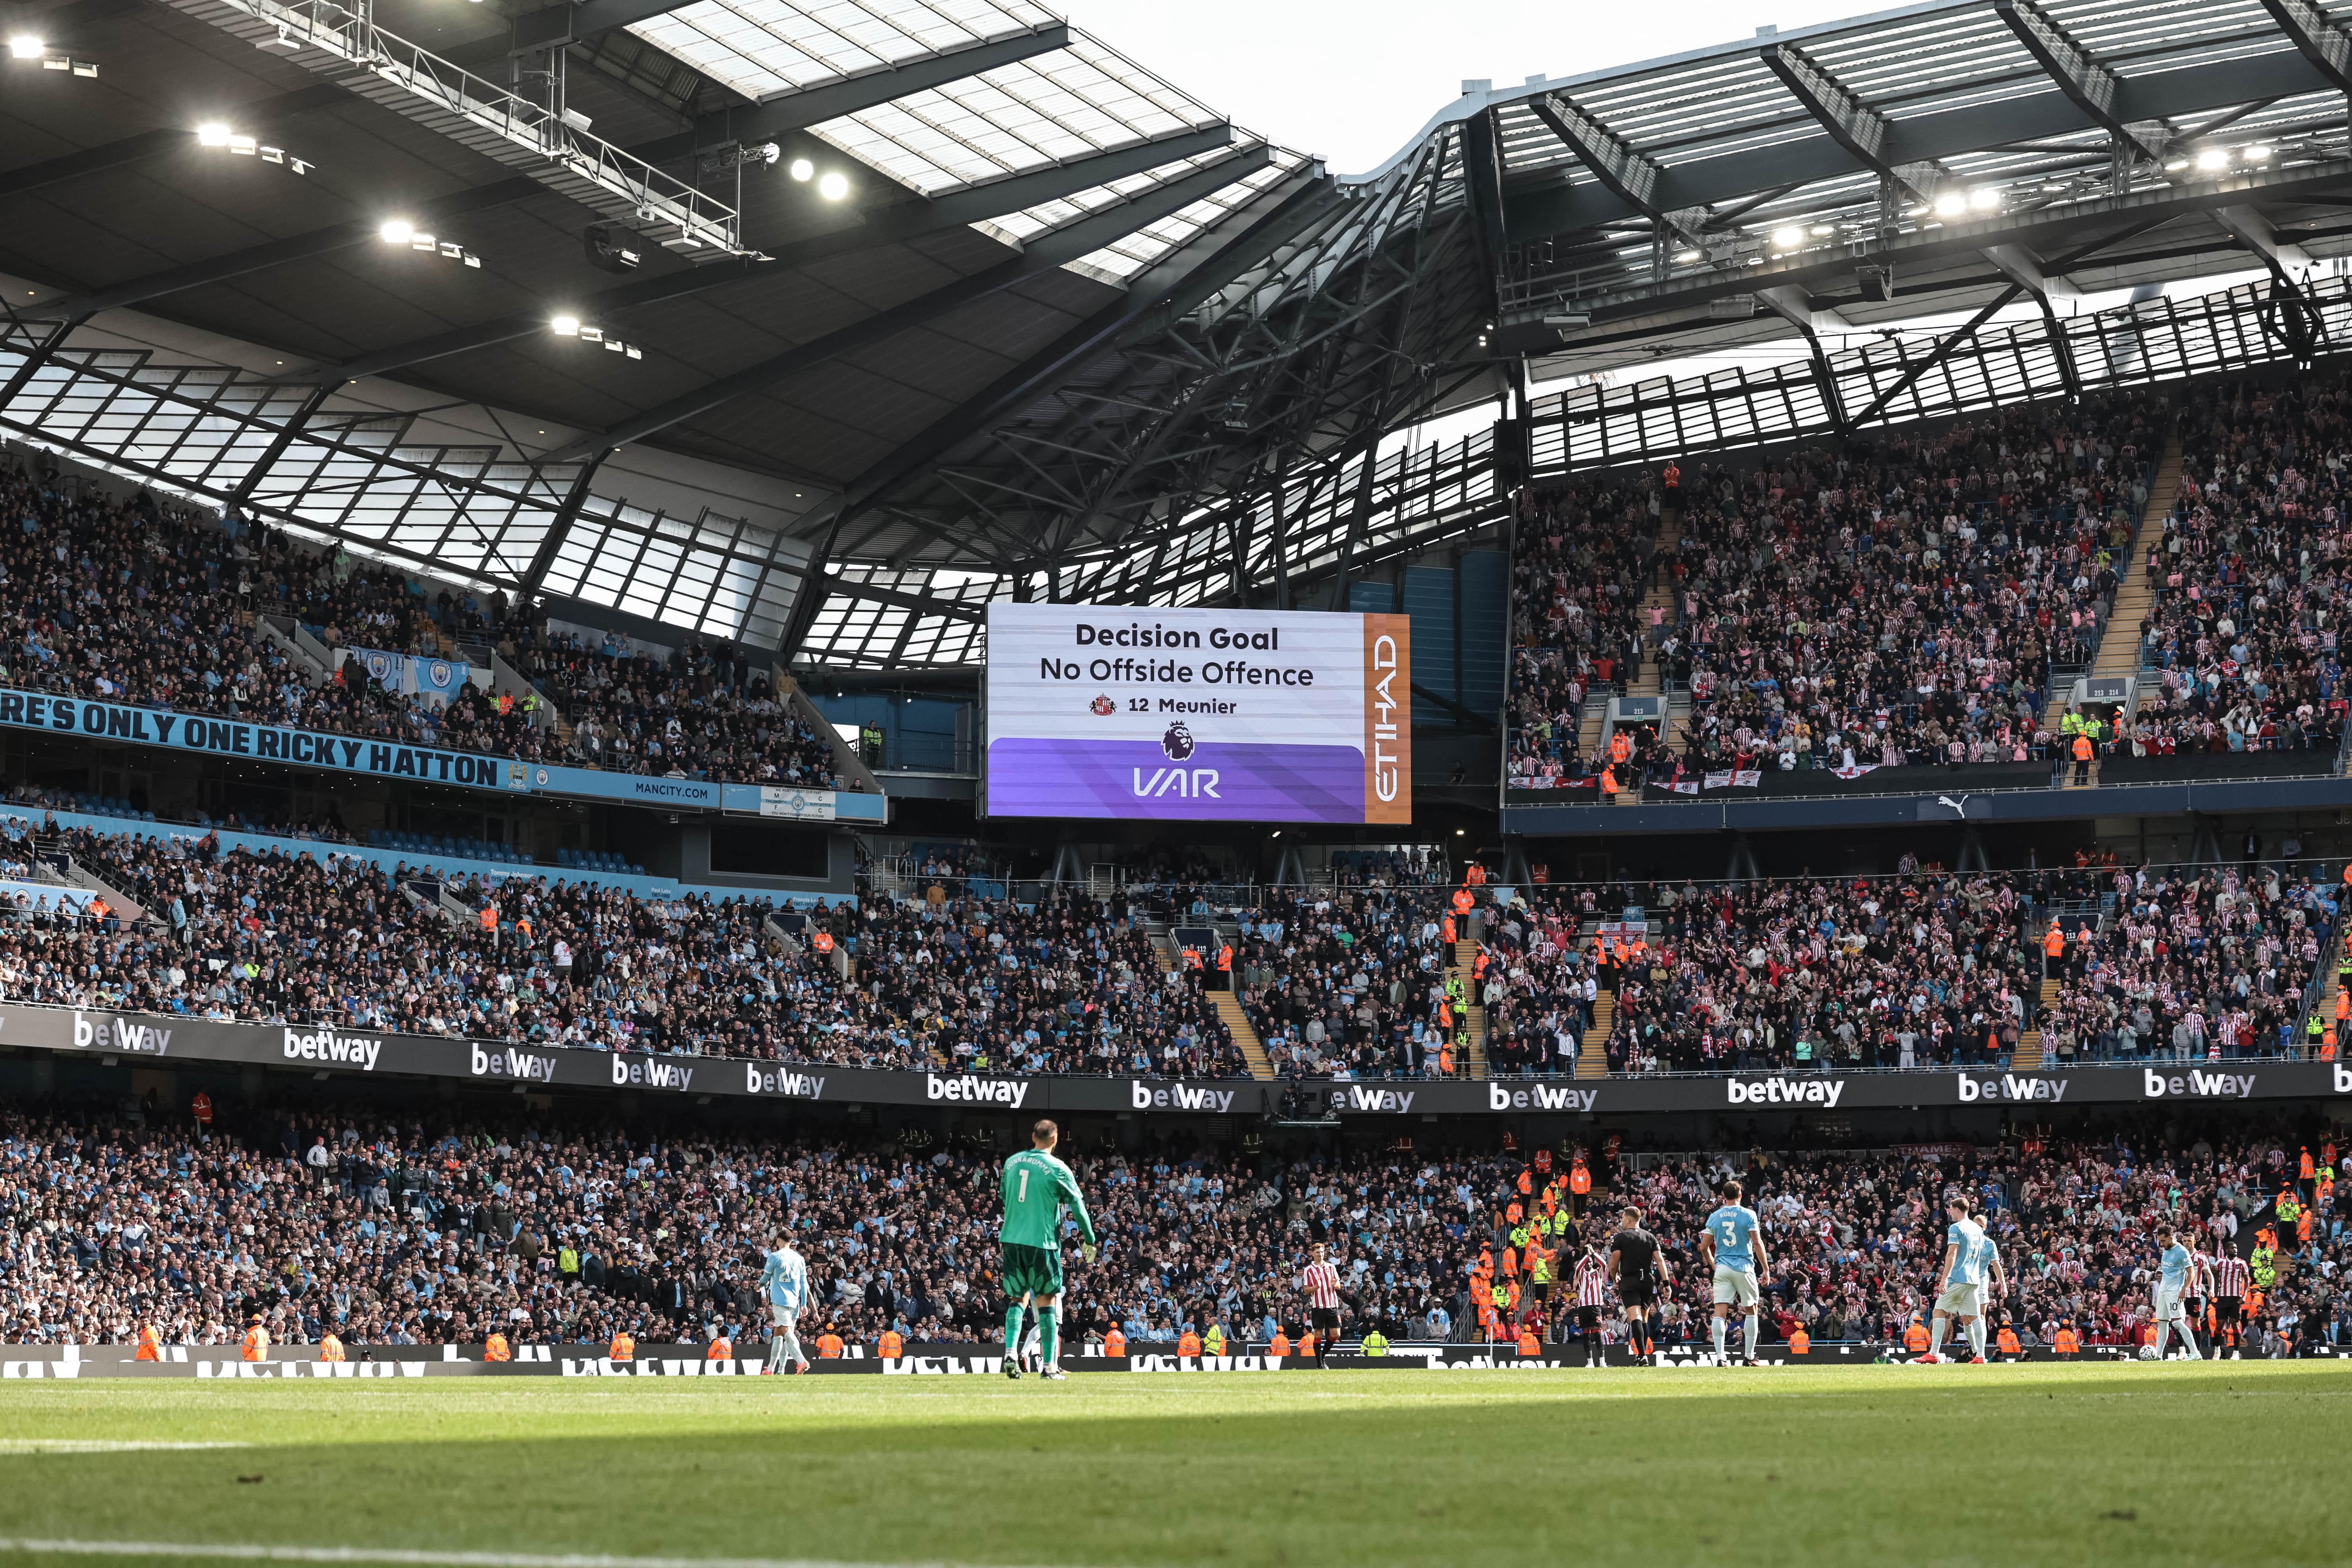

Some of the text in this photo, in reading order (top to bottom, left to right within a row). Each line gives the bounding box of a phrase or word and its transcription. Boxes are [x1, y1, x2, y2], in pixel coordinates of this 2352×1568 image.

[1077, 623, 1278, 650] Decision Goal
[1041, 658, 1313, 686] No Offside Offence
[1129, 698, 1237, 714] 12 Meunier
[1375, 635, 1397, 802] ETIHAD
[84, 705, 176, 743] ONLY
[185, 719, 250, 754] ONE
[257, 729, 363, 768] RICKY
[370, 745, 497, 787] HATTON
[636, 783, 707, 799] MANCITY.COM
[1134, 768, 1221, 798] VAR
[491, 869, 509, 878] Tommy
[1006, 1156, 1051, 1176] DONNARUMMA
[1018, 1169, 1029, 1202] 1
[1722, 1221, 1737, 1247] 3
